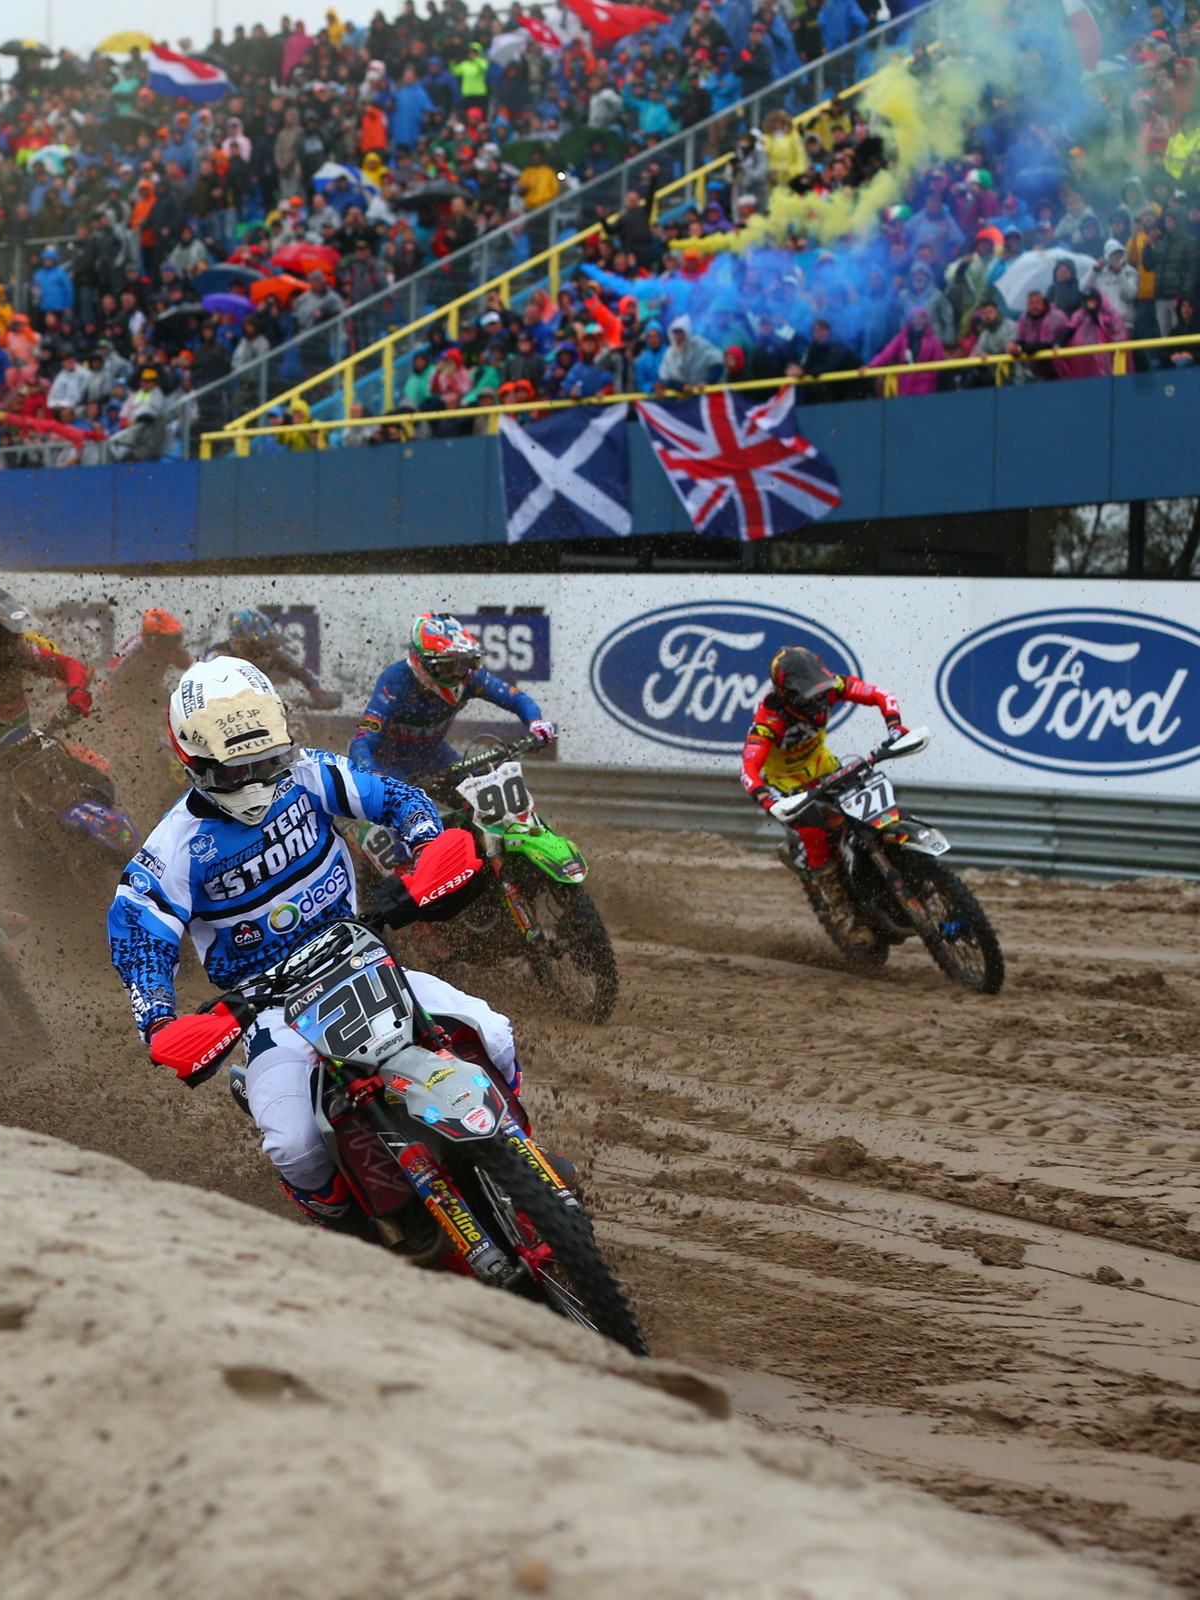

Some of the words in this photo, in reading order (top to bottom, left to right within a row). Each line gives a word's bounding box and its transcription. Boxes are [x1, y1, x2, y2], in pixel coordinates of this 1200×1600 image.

[642, 624, 772, 722] For
[997, 633, 1189, 746] Ford
[223, 721, 265, 737] BELL
[228, 737, 275, 755] OAKLEY
[263, 792, 313, 842] TEAM
[477, 776, 530, 825] 90
[855, 783, 889, 821] 27
[317, 961, 411, 1060] 24
